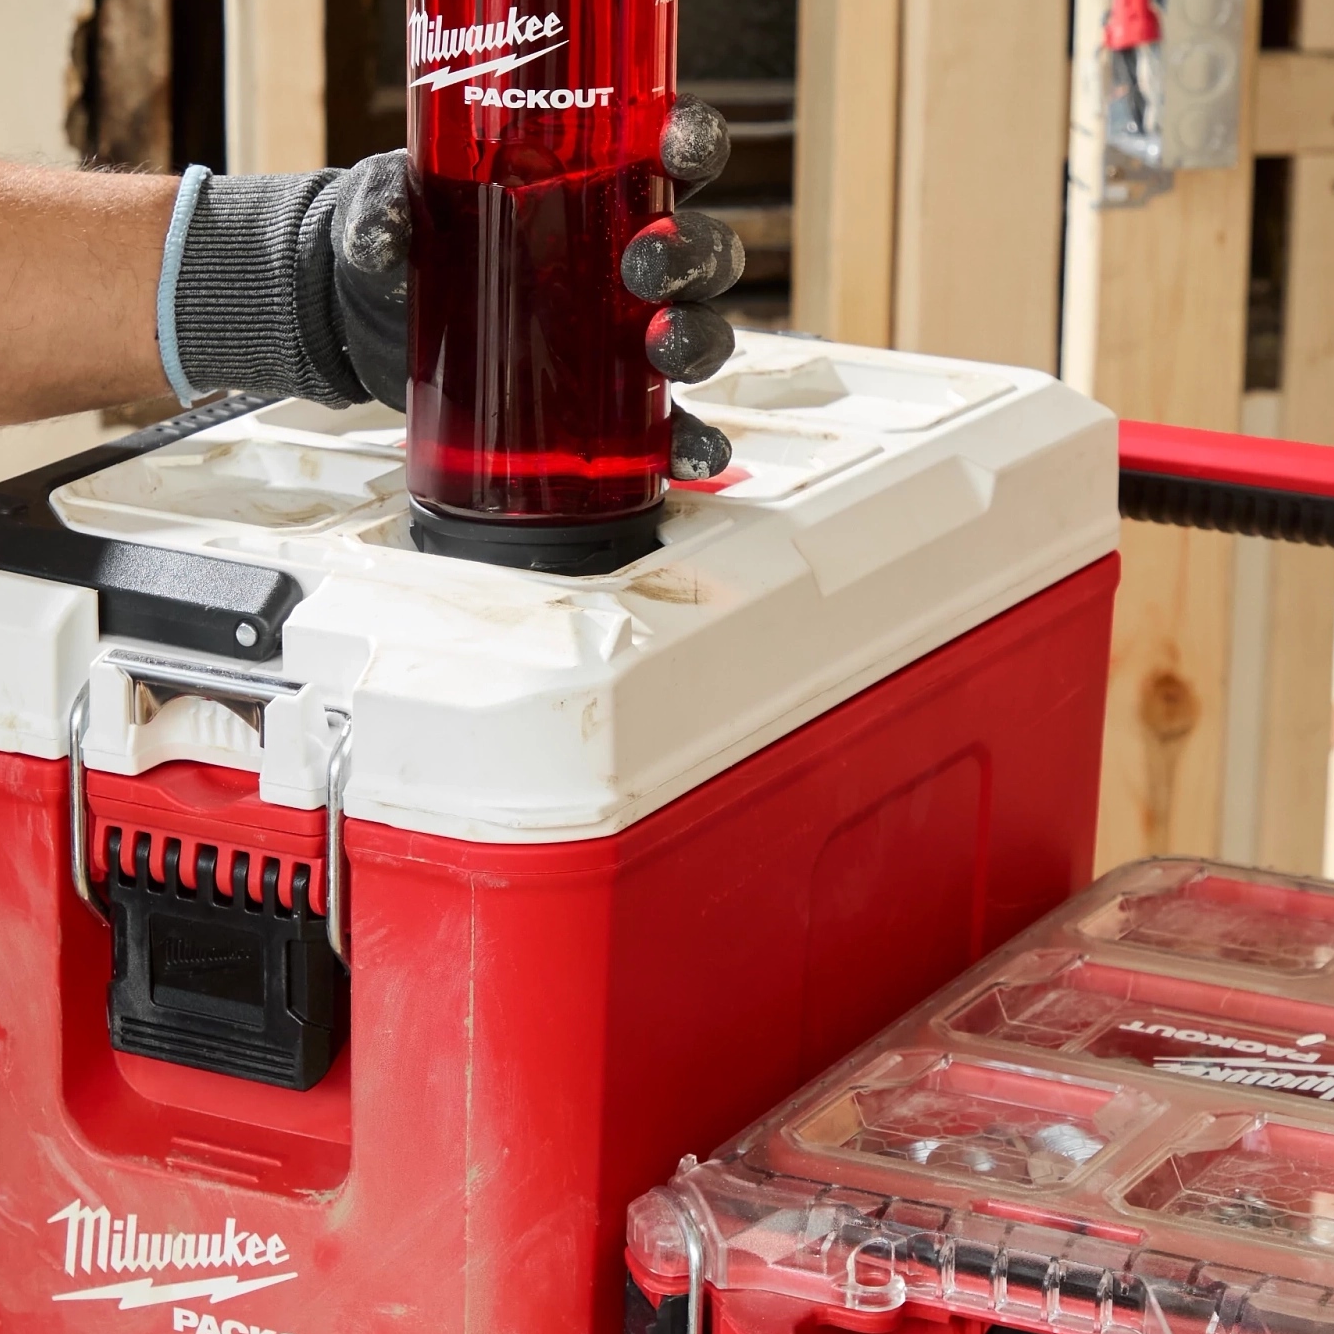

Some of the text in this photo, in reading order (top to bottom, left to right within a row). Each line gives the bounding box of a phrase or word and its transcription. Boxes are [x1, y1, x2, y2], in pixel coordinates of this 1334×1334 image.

[409, 6, 564, 69] Milwaukee
[464, 85, 614, 109] PACKOUT
[1119, 1020, 1322, 1064] PACKOUT
[46, 1198, 291, 1278] Milwaukee
